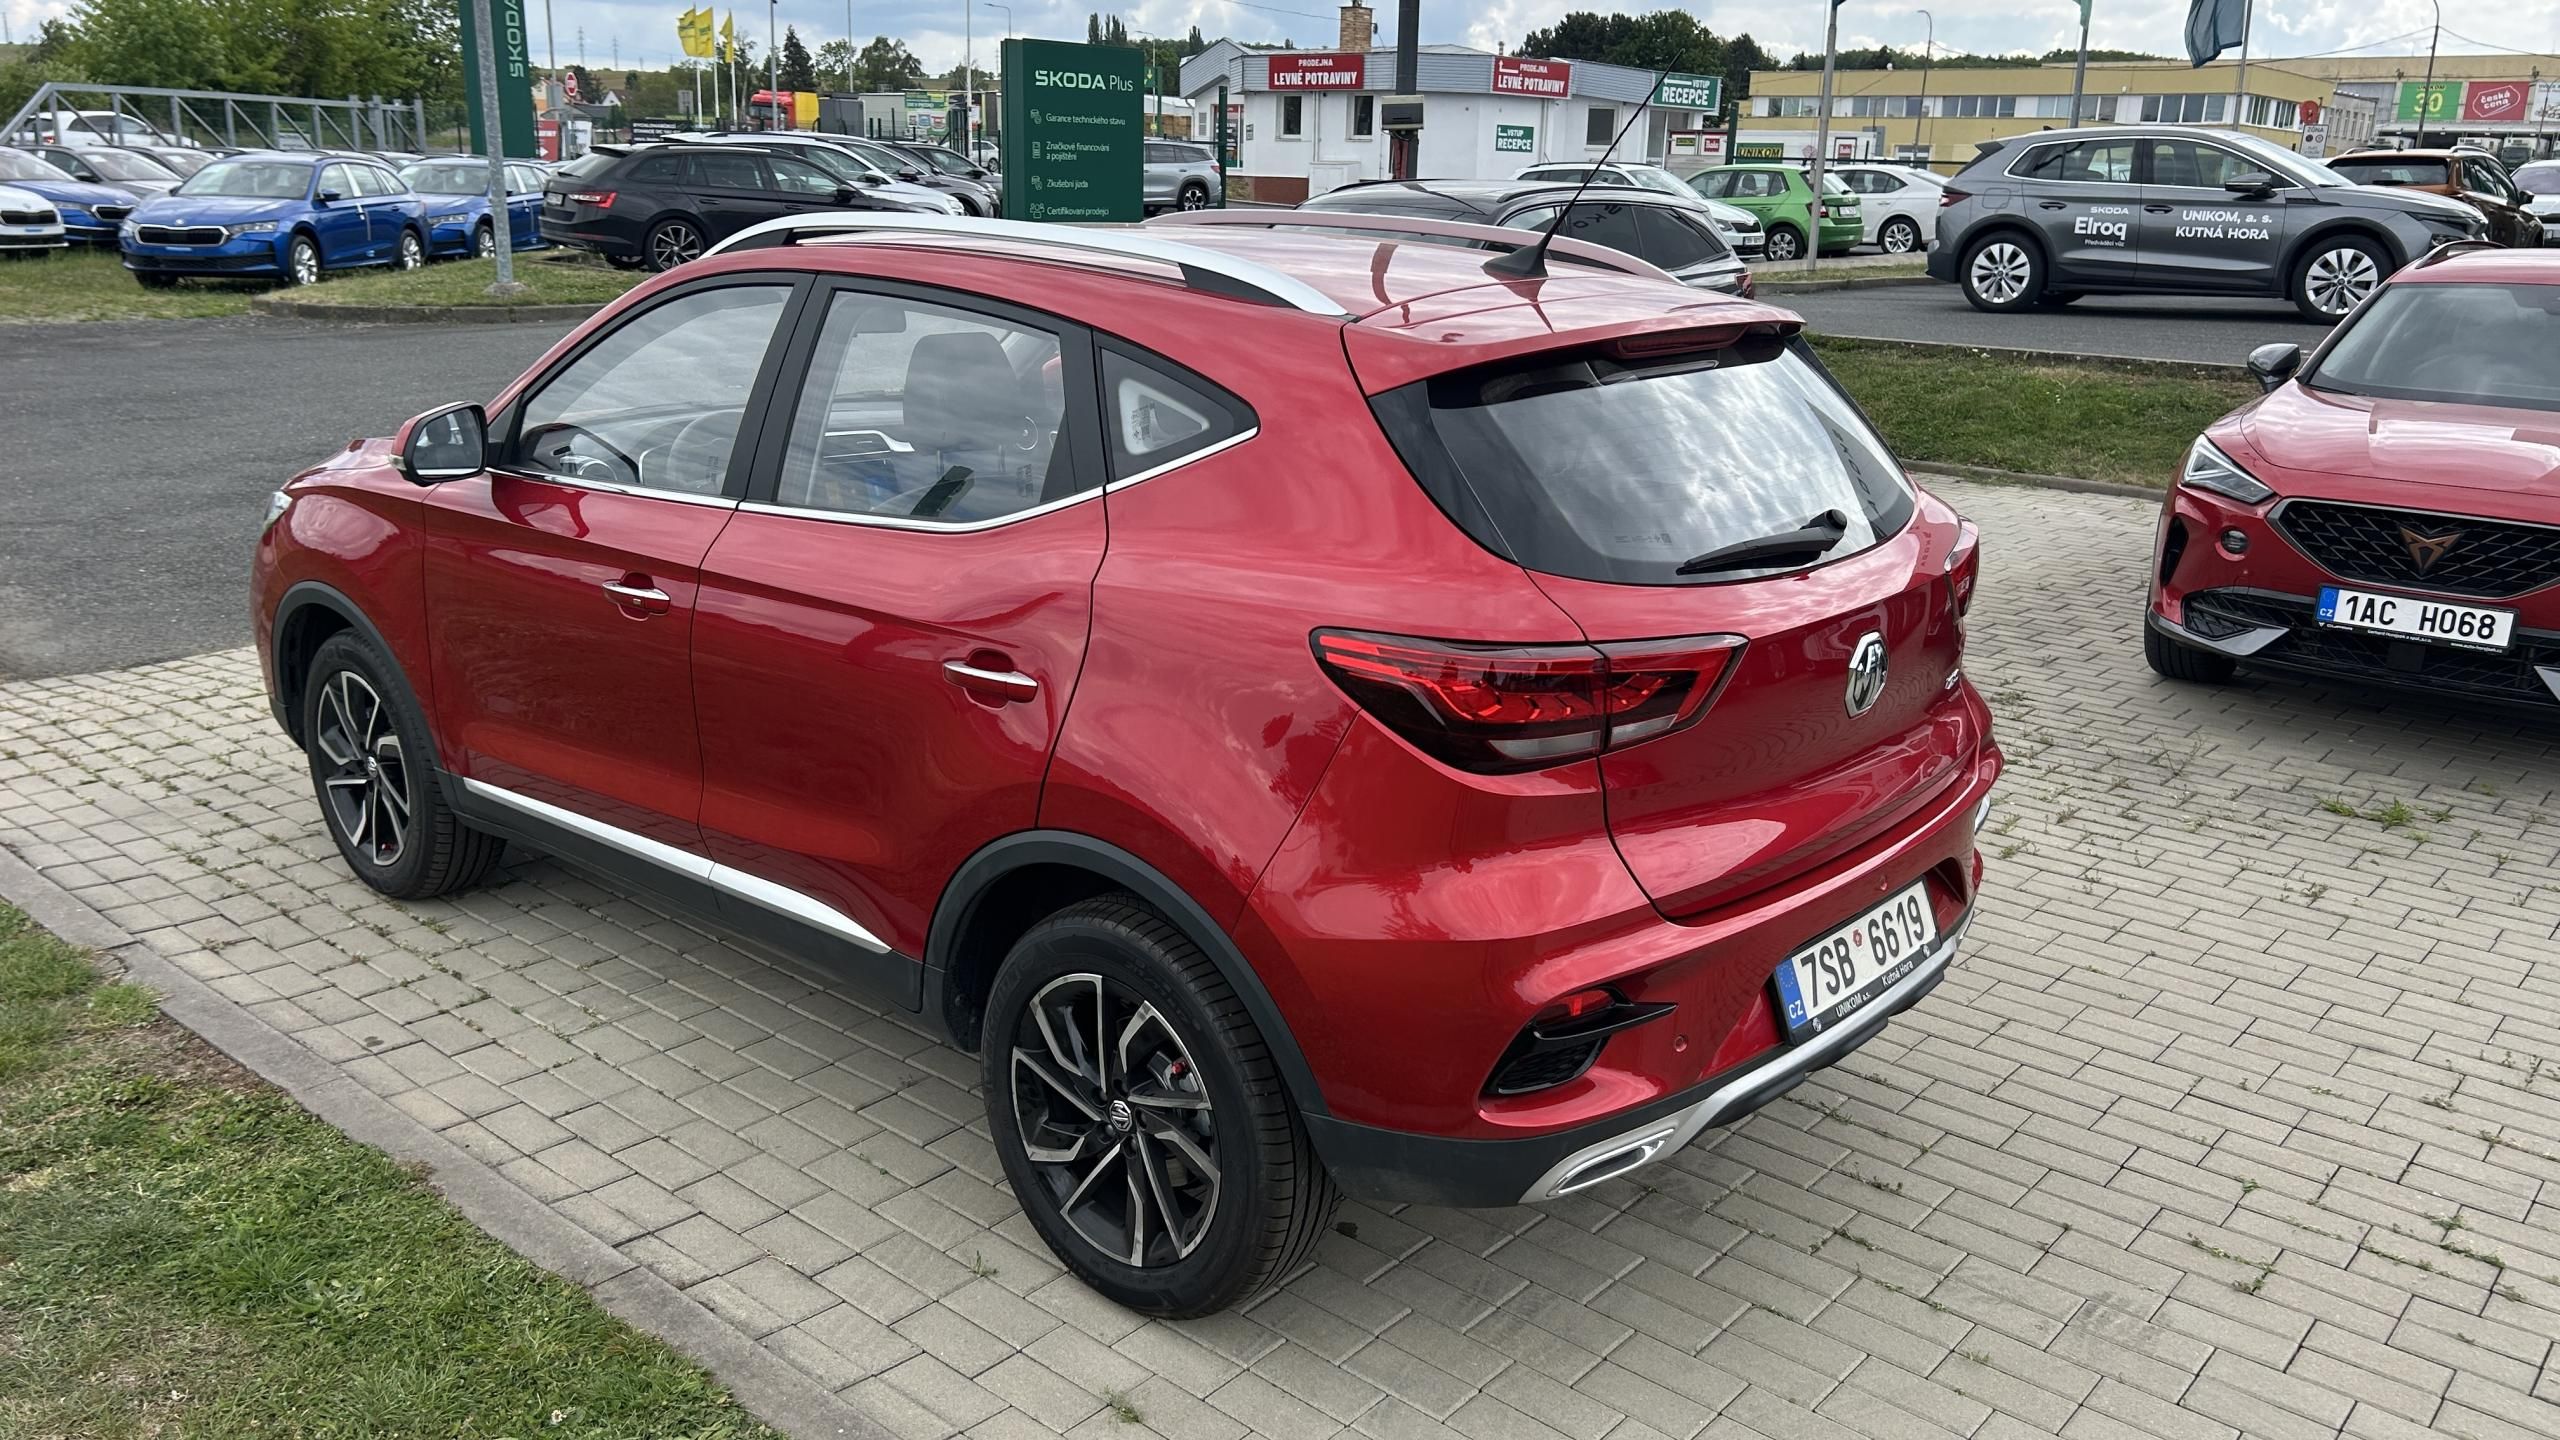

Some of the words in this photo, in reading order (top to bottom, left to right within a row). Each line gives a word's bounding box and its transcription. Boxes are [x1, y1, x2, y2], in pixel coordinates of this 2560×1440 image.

[1298, 58, 1333, 67] PRODEJNA
[1520, 63, 1548, 74] PRODEJNA
[1109, 74, 1134, 92] Plus
[1274, 69, 1303, 86] LEVNÉ
[1305, 71, 1358, 85] POTRAVINY
[1498, 74, 1523, 90] LEVNÉ
[1523, 77, 1565, 94] POTRAVINY
[1692, 79, 1710, 89] VSTUP
[1661, 86, 1710, 106] RECEPCE
[2414, 92, 2443, 112] 30
[2480, 89, 2511, 104] česká
[2483, 97, 2509, 109] cena
[1507, 129, 1524, 137] VSTUP
[1497, 138, 1532, 150] RECEPCE
[1739, 147, 1781, 157] UNIKOM
[2182, 209, 2241, 225] UNIKOM,
[2245, 214, 2257, 223] a.
[2261, 214, 2273, 223] s.
[2073, 216, 2127, 241] Elroq
[2175, 224, 2224, 239] KUTNÁ
[2227, 227, 2269, 240] HORA
[2319, 606, 2333, 617] CZ
[2345, 595, 2397, 626] 1AC
[1799, 936, 1856, 1009] 7SB
[1867, 894, 1925, 967] 6619
[1881, 967, 1900, 988] Kutná
[1899, 960, 1914, 976] Hora
[1788, 999, 1804, 1019] CZ
[1835, 992, 1862, 1018] UNIKOM
